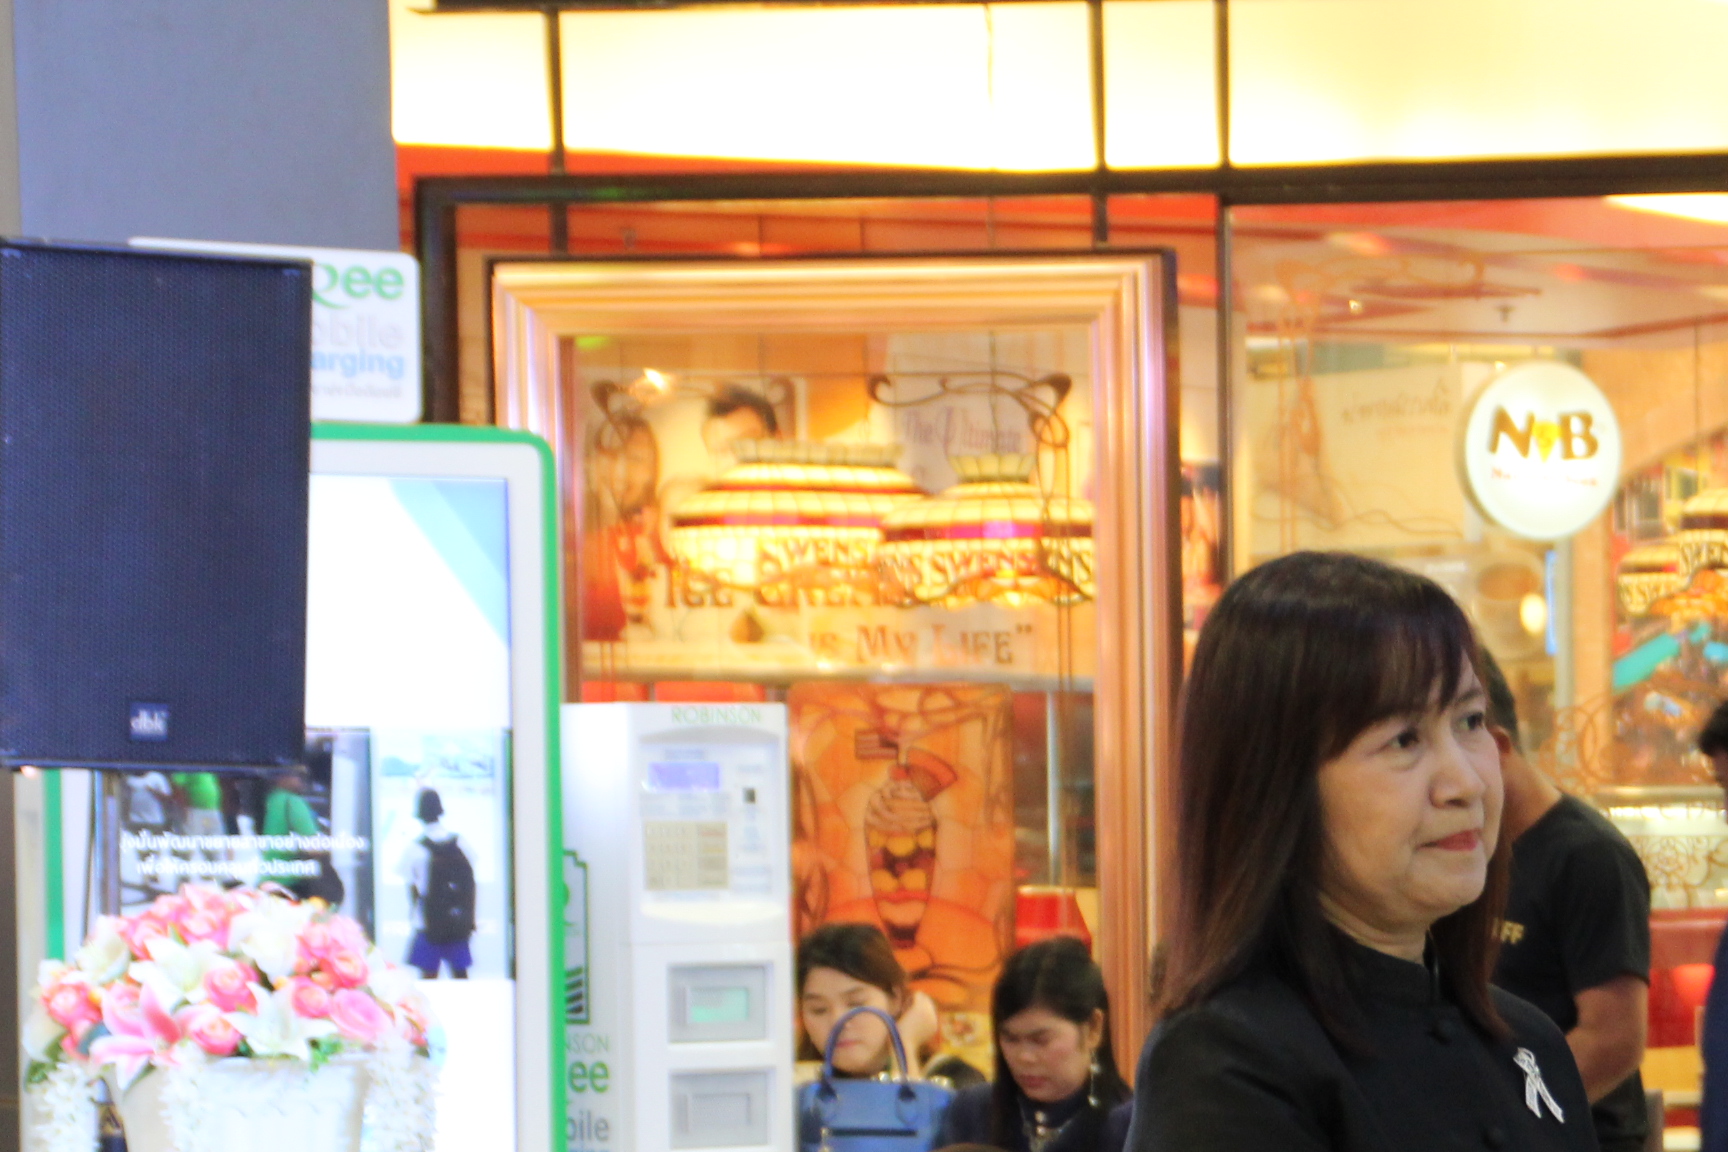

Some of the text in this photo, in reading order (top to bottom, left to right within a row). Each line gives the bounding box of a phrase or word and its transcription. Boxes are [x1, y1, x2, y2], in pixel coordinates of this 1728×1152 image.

[312, 348, 405, 380] arging
[671, 705, 762, 723] ROBINSON
[568, 1060, 610, 1094] ee
